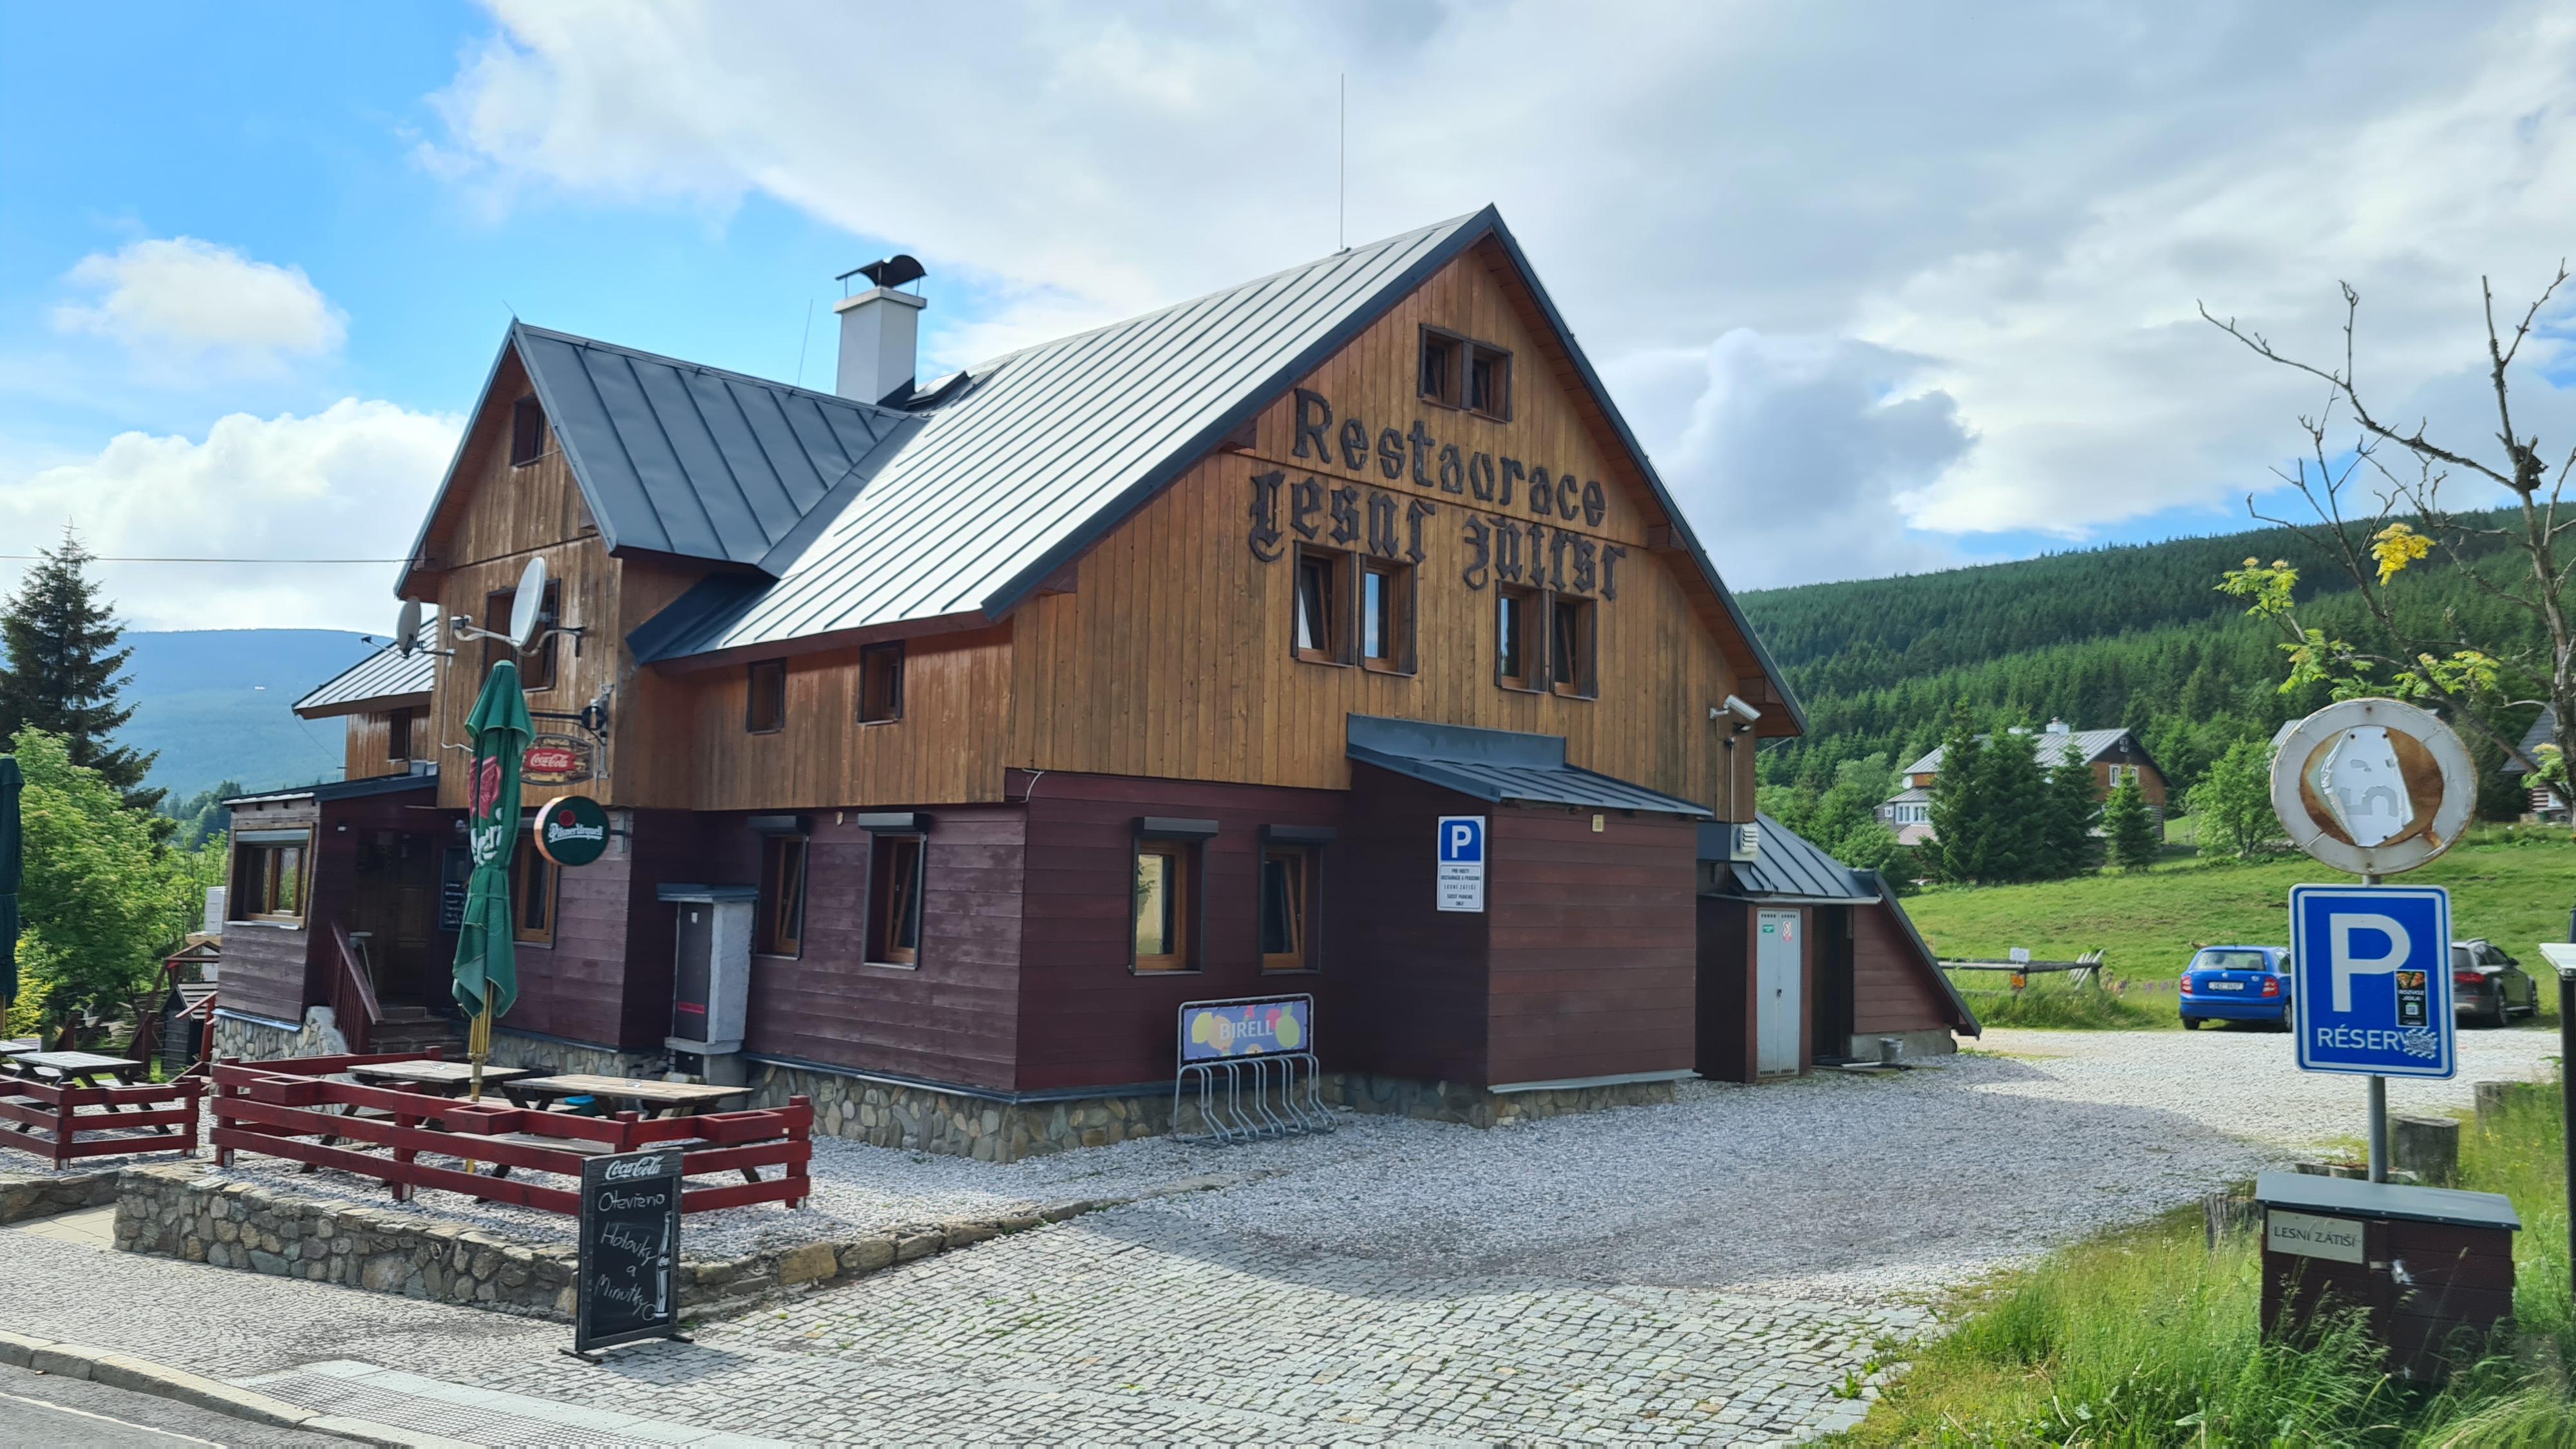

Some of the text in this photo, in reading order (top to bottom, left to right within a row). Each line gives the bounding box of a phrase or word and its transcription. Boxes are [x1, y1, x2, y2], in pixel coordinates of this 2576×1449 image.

[1292, 388, 1605, 526] Restaurace
[1452, 825, 1472, 858] P
[2329, 913, 2411, 1012] P
[1219, 1019, 1274, 1040] BIRELL
[605, 1155, 665, 1180] Coca-Cola
[626, 1265, 636, 1277] a
